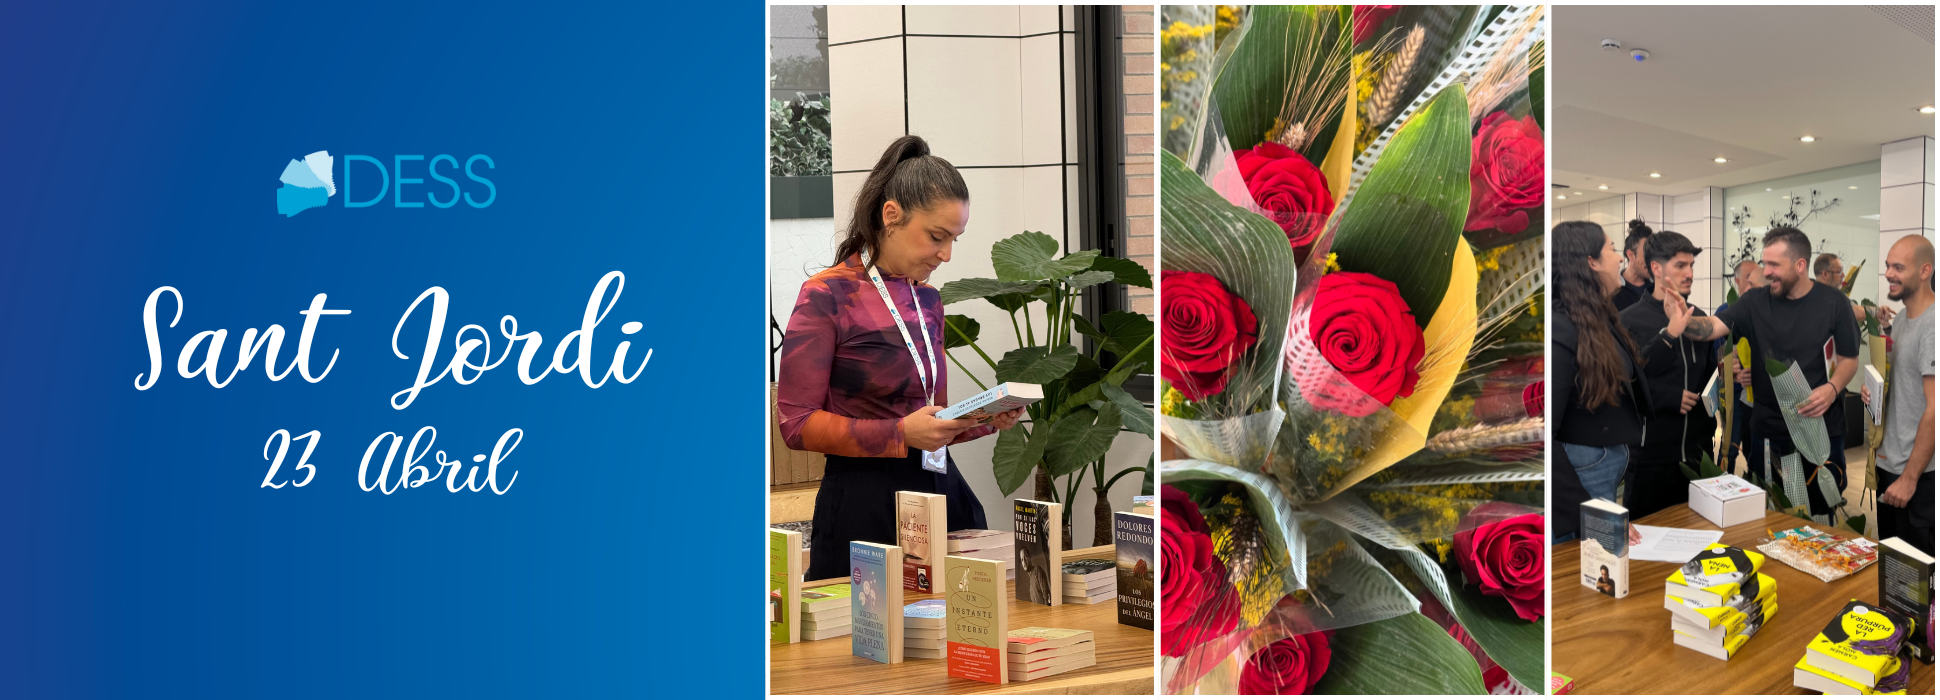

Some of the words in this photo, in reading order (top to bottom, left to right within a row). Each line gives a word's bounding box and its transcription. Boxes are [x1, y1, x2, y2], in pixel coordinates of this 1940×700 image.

[876, 282, 889, 299] DESS
[894, 314, 906, 332] DESS
[900, 520, 928, 534] PACIENTE
[1016, 520, 1036, 534] VOCES
[1118, 519, 1152, 534] DOLORES
[1016, 532, 1036, 543] VUELVEN
[1116, 531, 1154, 546] REDONDO
[852, 546, 870, 556] BRONNIE
[1709, 560, 1730, 570] NENA
[952, 607, 992, 619] INSTANTE
[1133, 606, 1153, 620] ÁNGEL
[957, 624, 988, 634] ETERNO
[1850, 614, 1891, 632] PÚRPURA
[1856, 624, 1874, 633] RED
[855, 634, 867, 646] VIDA
[868, 637, 884, 650] PLENA
[1830, 647, 1857, 660] CARMEN
[1838, 645, 1856, 654] MOLA
